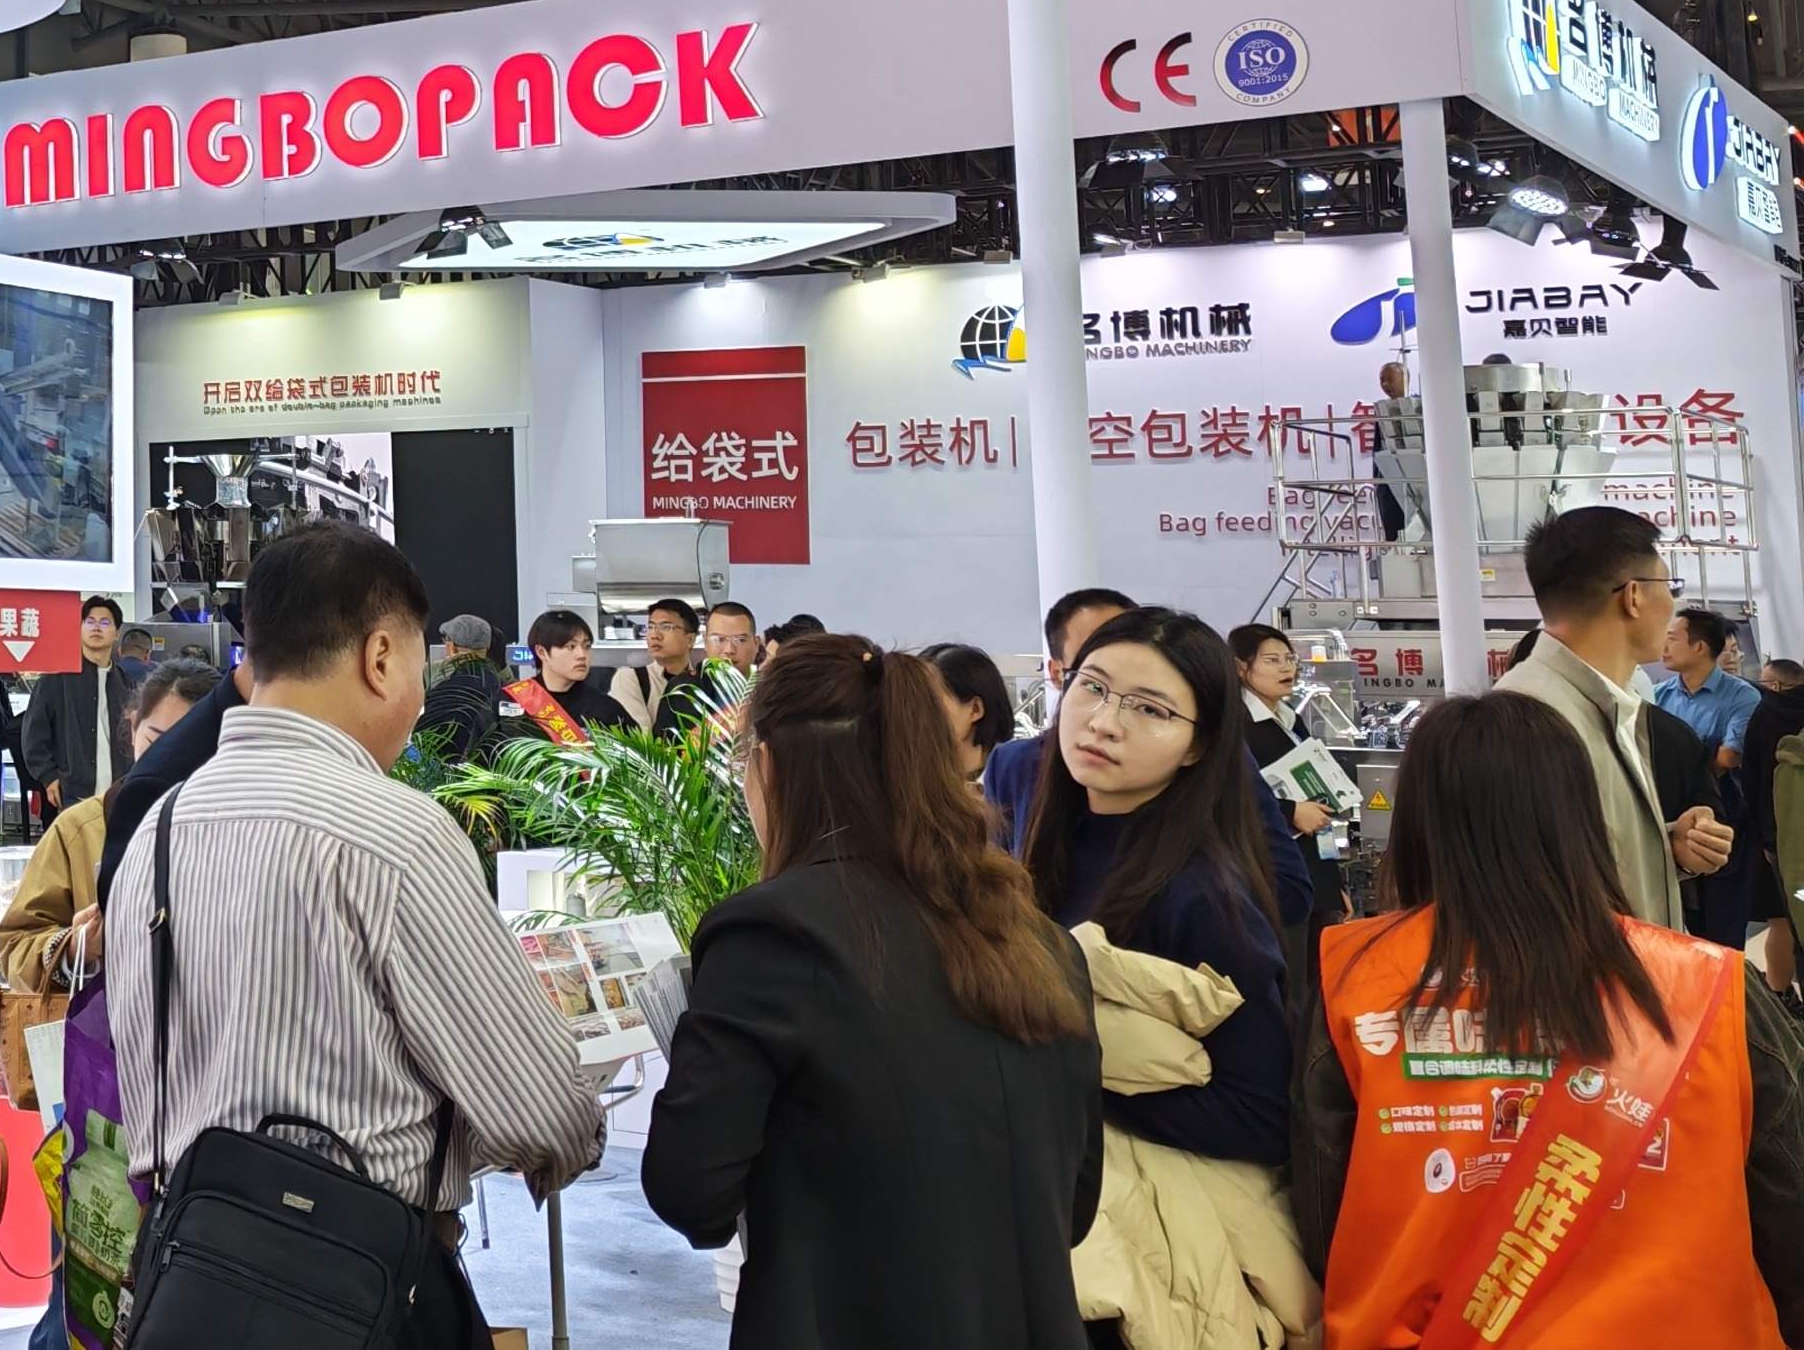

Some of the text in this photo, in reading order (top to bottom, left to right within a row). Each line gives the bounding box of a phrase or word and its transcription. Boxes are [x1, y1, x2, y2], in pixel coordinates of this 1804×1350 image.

[1227, 21, 1293, 42] CERTIFIED
[1238, 46, 1285, 70] ISO
[1237, 72, 1289, 88] 9001:2015
[1236, 86, 1292, 103] COMPANY
[3, 22, 764, 210] MINGBOPACK
[1465, 282, 1643, 314] JIABAY
[1503, 318, 1608, 339] 嘉贝智能
[1145, 338, 1253, 358] MACHINERY
[203, 370, 442, 404] 开启双给袋式包装机时代
[1610, 388, 1745, 448] 设备
[650, 431, 800, 484] 给袋式
[713, 495, 798, 511] MACHINERY
[1159, 513, 1207, 537] Bag
[0, 606, 41, 639] 果蔬
